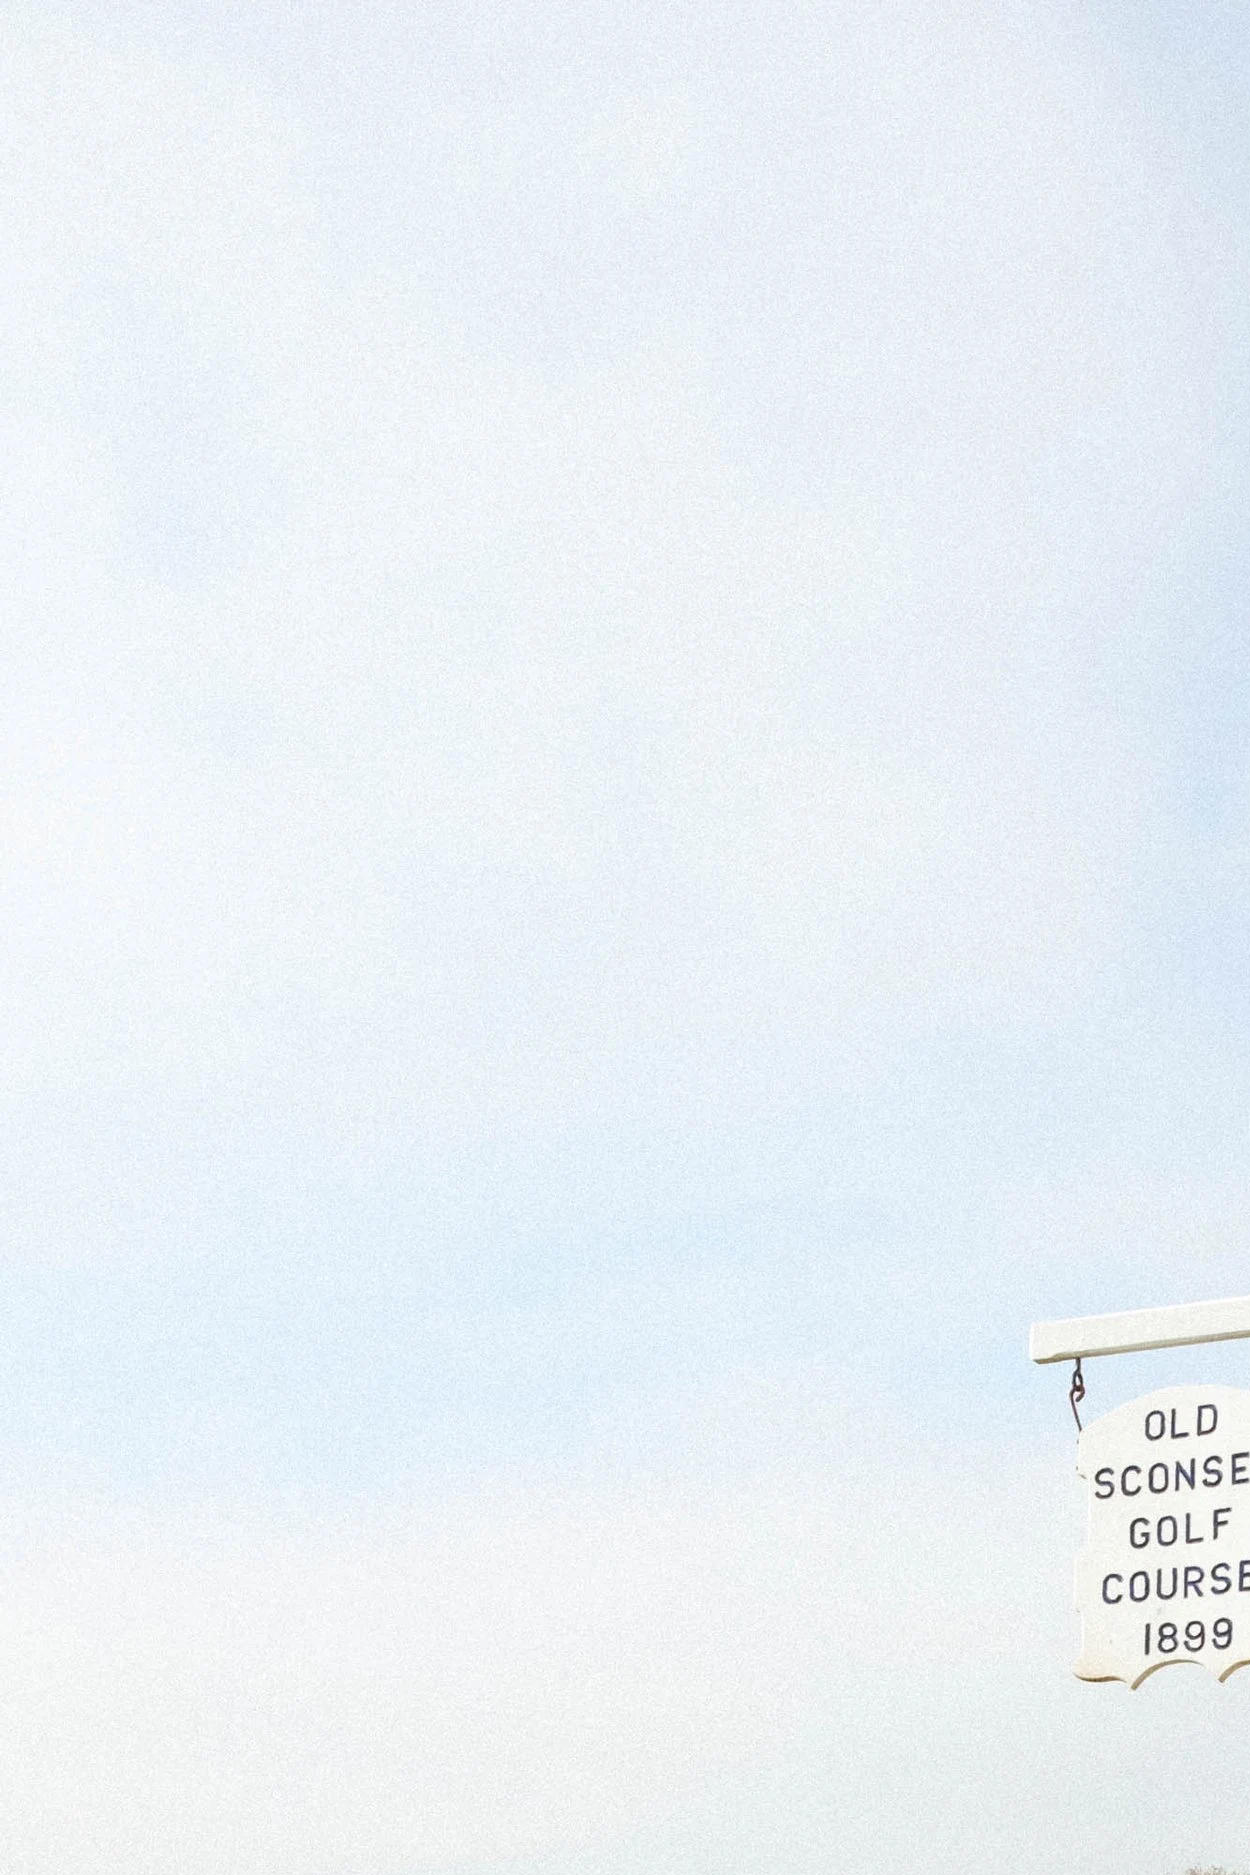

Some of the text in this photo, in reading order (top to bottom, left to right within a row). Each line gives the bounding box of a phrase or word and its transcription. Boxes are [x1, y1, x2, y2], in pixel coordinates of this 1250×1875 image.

[1144, 1404, 1218, 1441] OLD
[1129, 1507, 1232, 1550] GOLF
[1144, 1617, 1233, 1656] 1899
